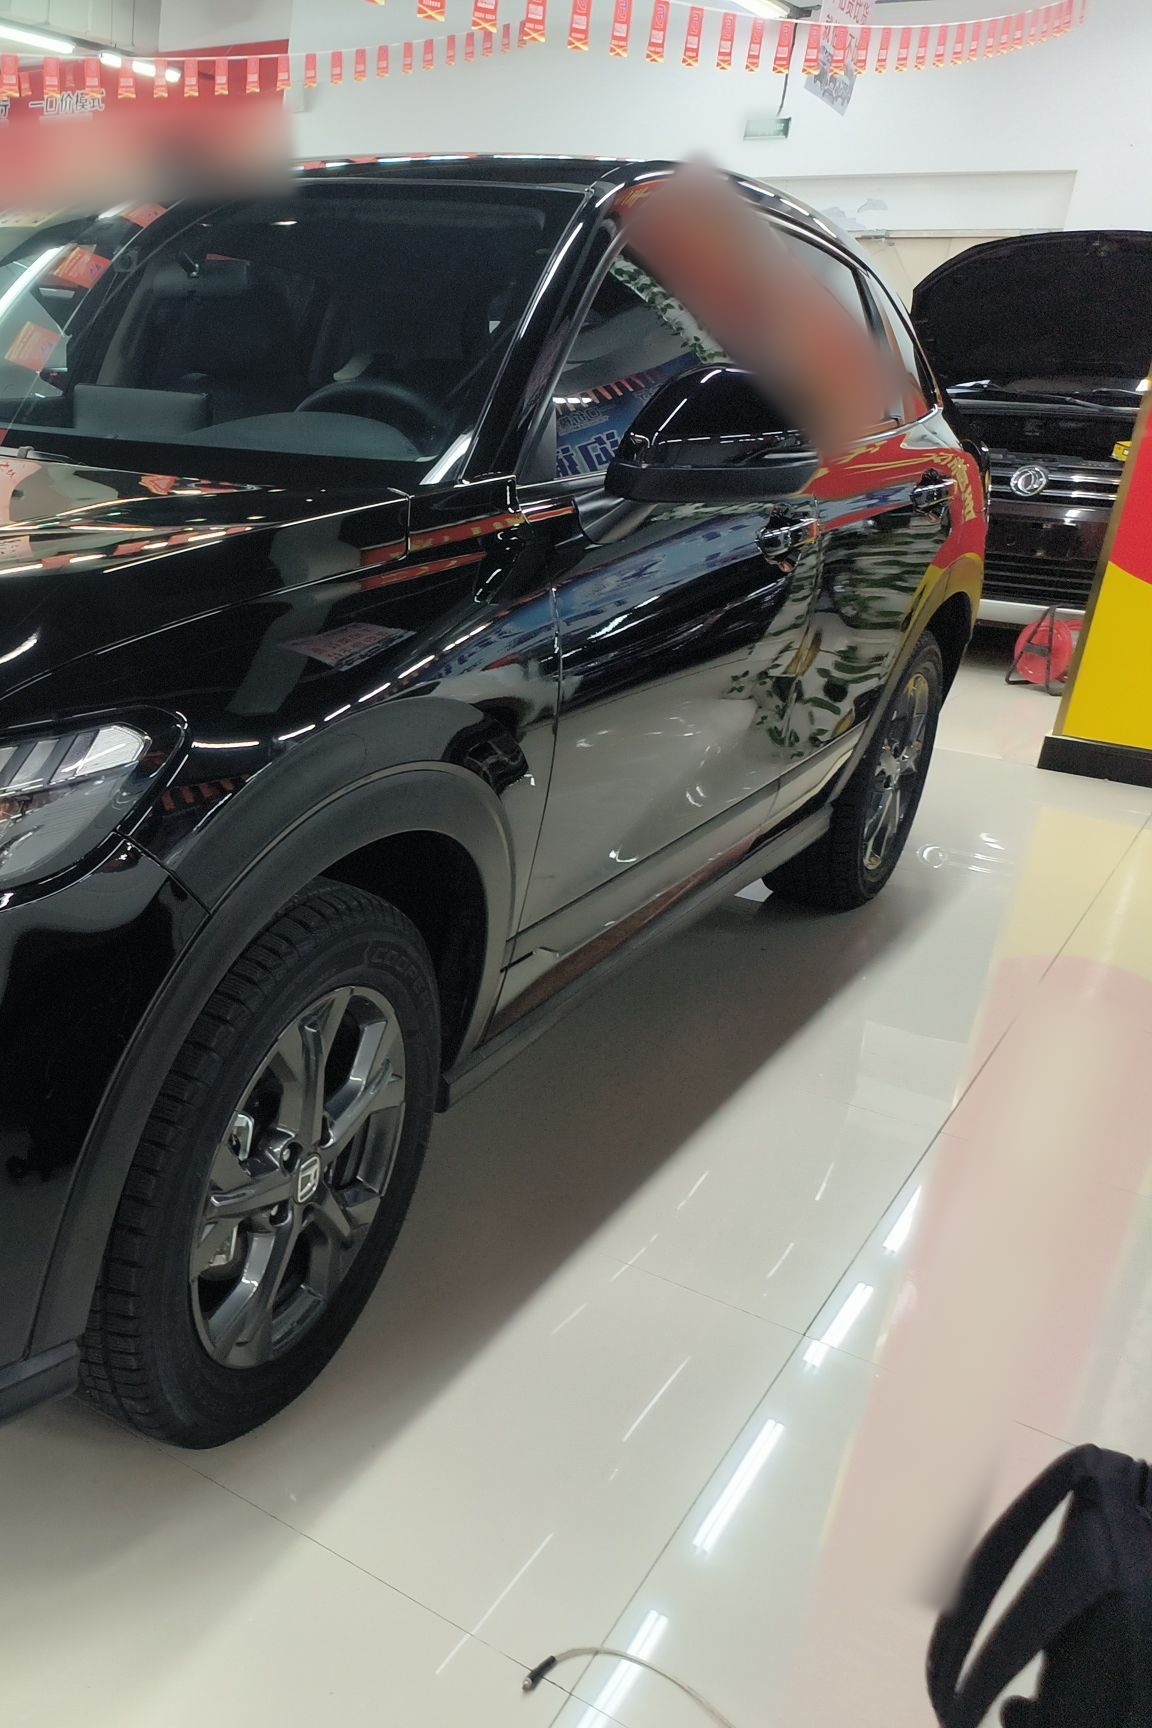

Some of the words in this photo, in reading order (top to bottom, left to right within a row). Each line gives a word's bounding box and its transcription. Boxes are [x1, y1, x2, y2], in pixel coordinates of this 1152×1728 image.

[29, 89, 105, 115] 一口价模式
